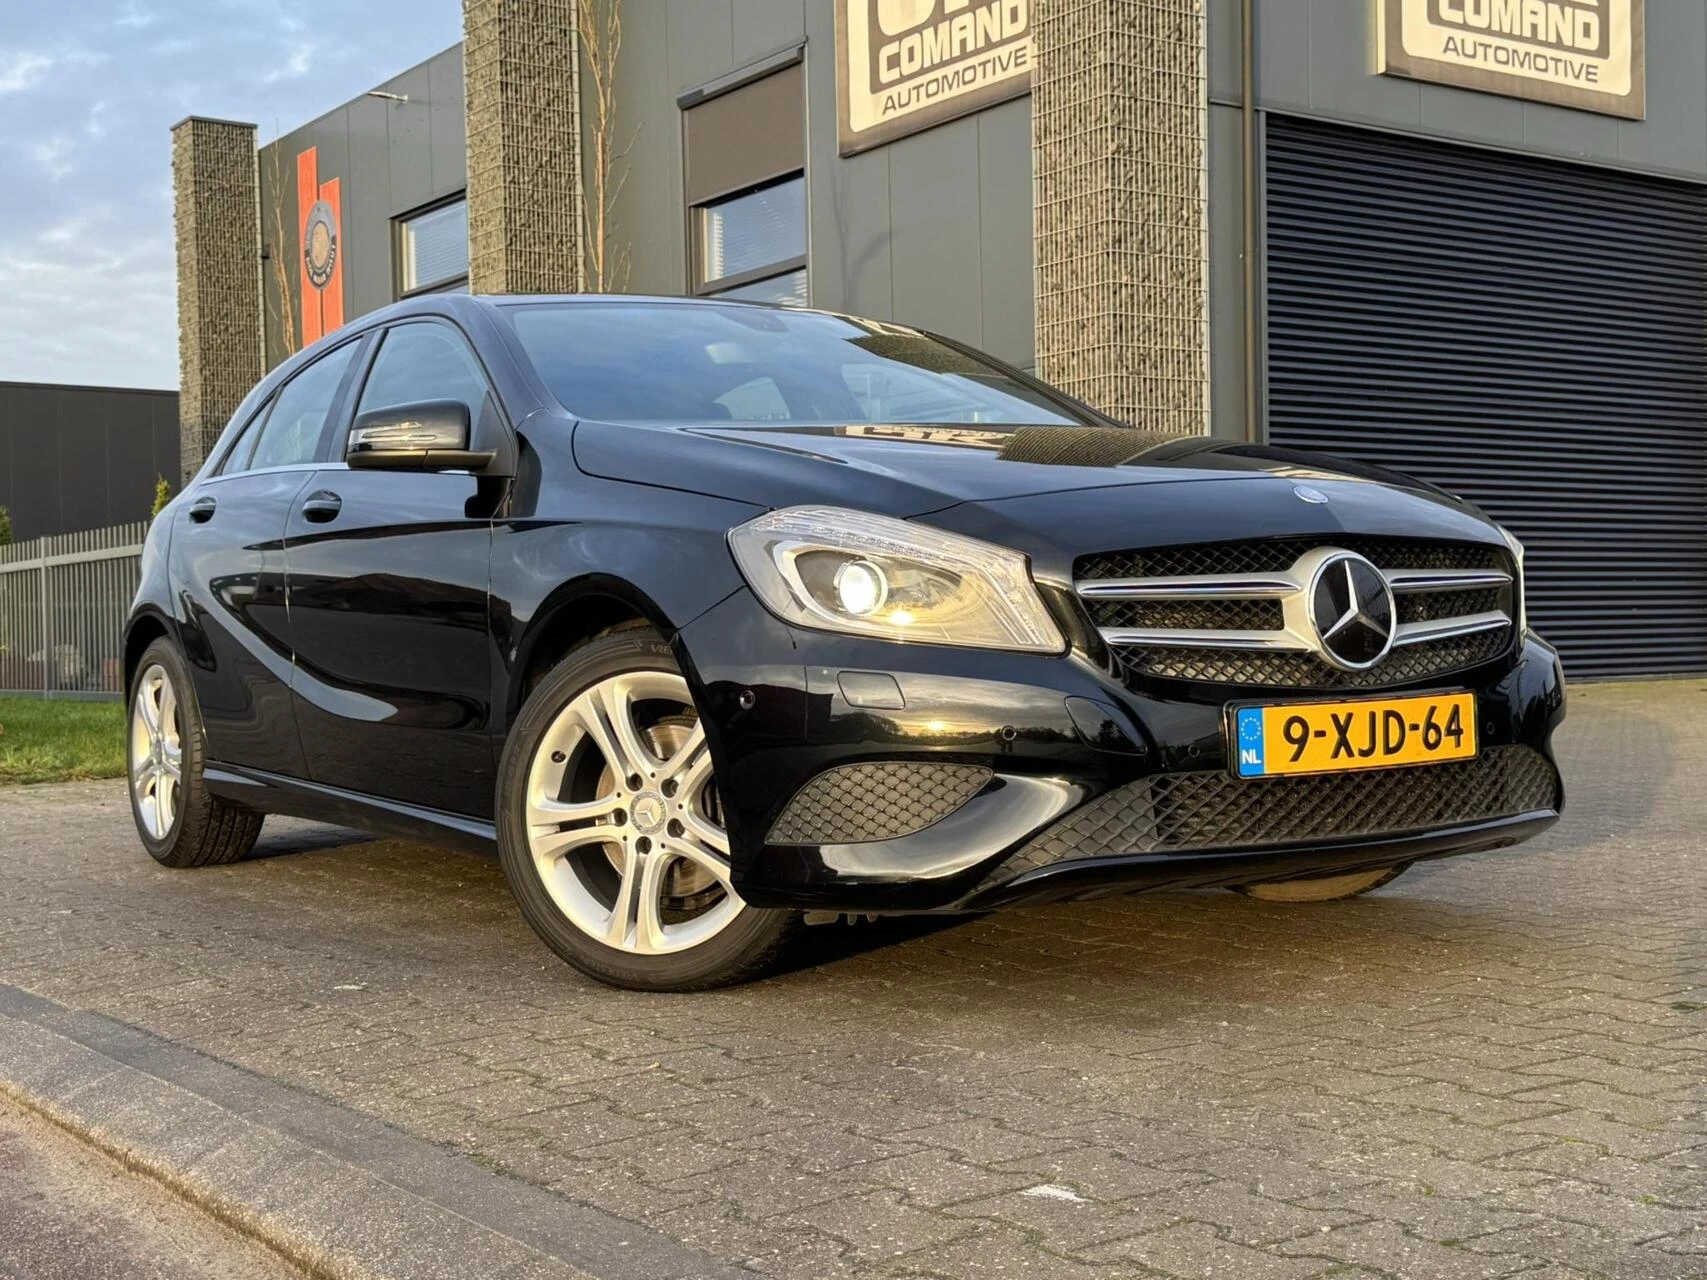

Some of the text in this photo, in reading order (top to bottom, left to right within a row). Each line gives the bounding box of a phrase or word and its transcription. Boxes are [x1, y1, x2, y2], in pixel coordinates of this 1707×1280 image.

[879, 0, 1028, 84] COMAND
[1443, 36, 1598, 83] AUTOMOTIVE
[882, 46, 1028, 115] AUTOMOTIVE
[1242, 749, 1261, 764] NL
[1283, 704, 1464, 762] 9-XJD-64
